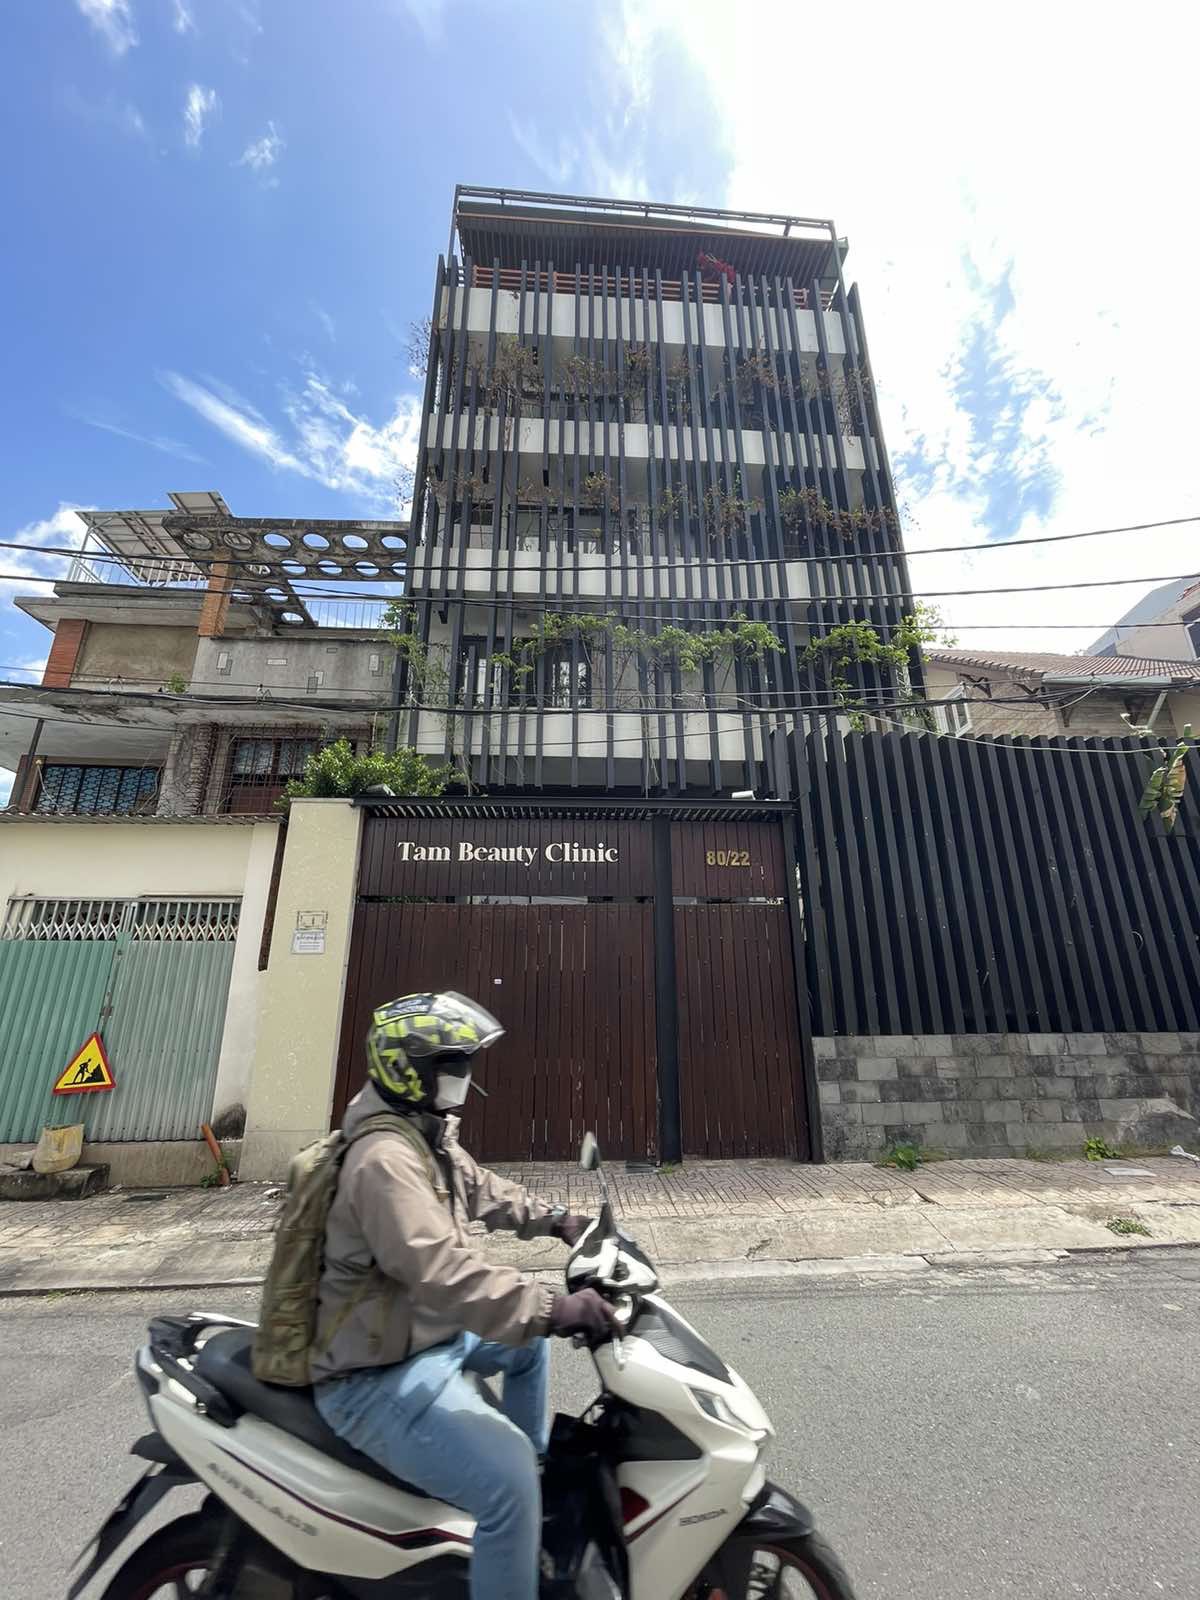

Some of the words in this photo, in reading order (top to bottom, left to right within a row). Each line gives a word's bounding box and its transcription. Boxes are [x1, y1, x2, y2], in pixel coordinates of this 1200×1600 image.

[397, 841, 451, 861] Tam
[458, 842, 538, 867] Beauty
[545, 842, 619, 862] Clinic
[706, 849, 750, 866] 80/22
